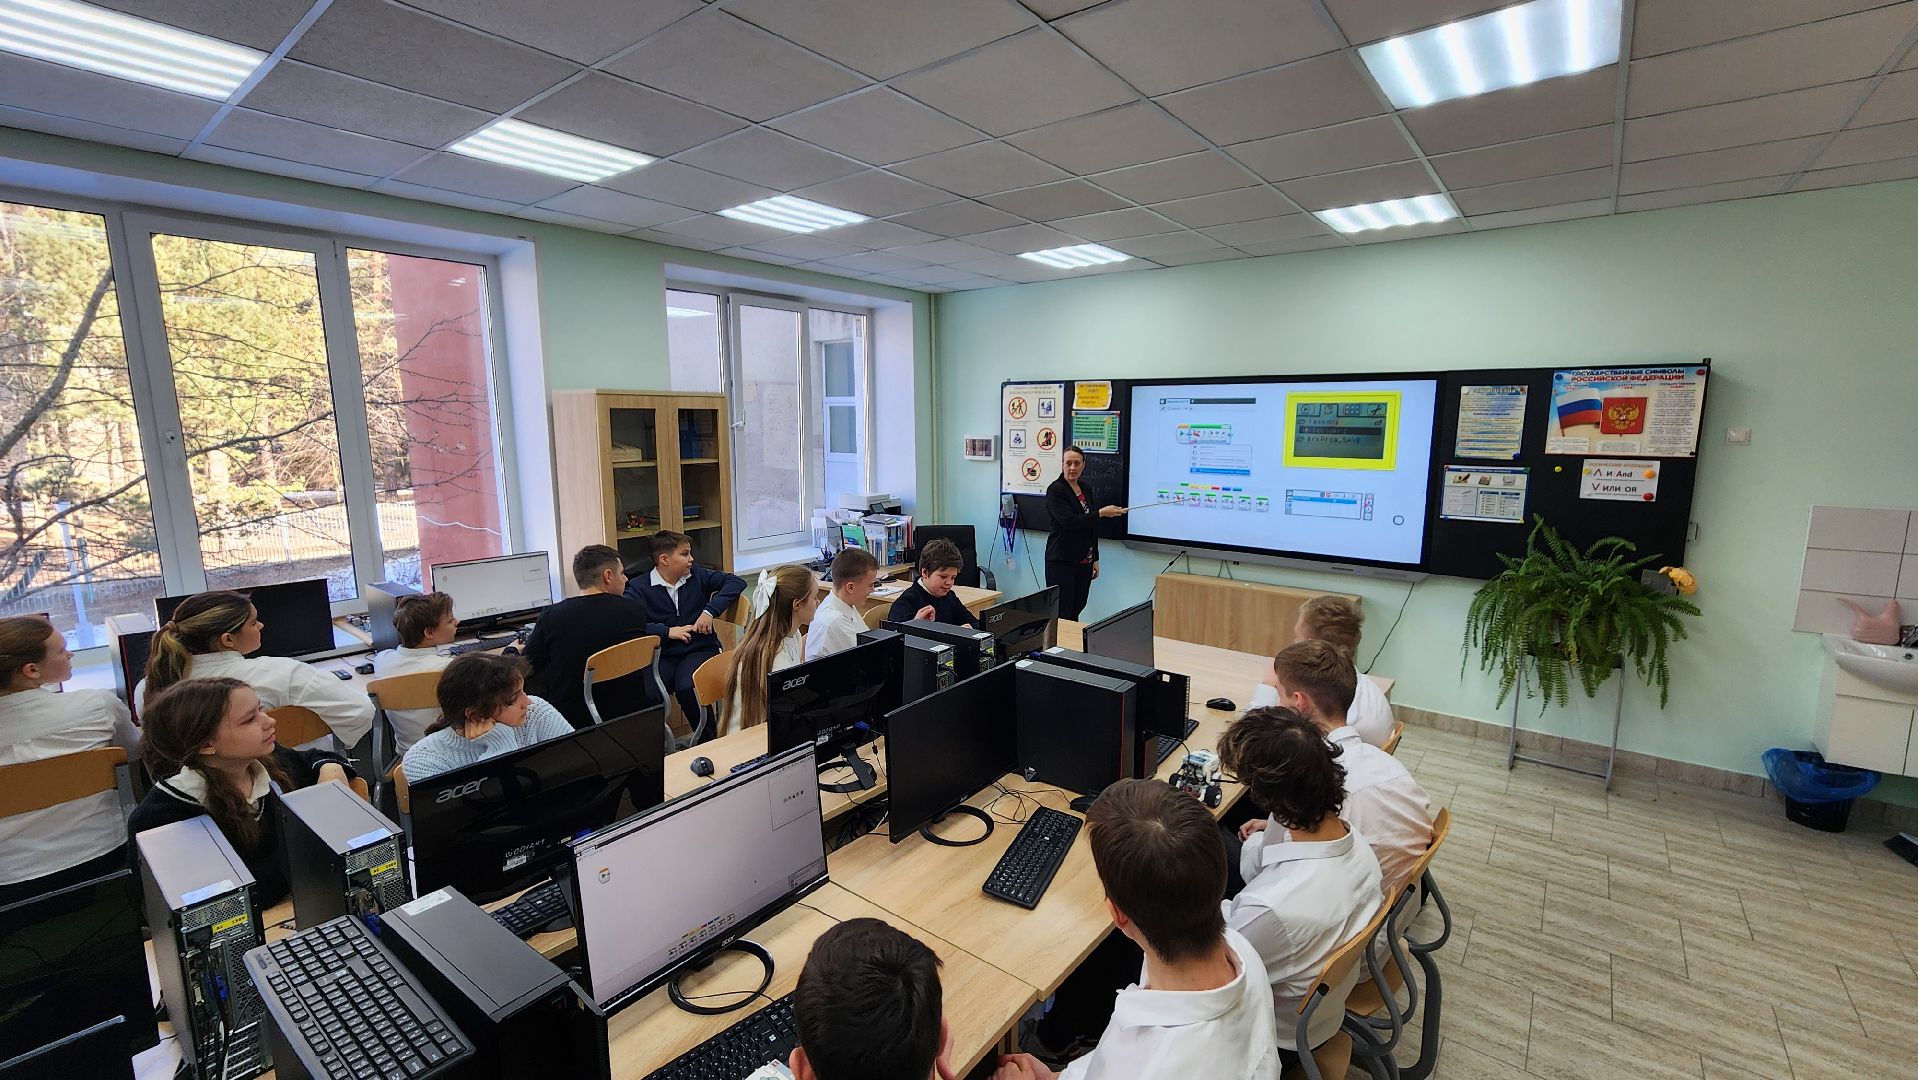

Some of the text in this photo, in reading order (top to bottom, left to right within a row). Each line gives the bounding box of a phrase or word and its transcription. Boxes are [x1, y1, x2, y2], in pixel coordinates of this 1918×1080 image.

[1645, 367, 1685, 375] СИМВОЛЫ
[1629, 374, 1685, 382] ФЕДЕРАЦИИ
[1616, 470, 1633, 478] And
[989, 611, 1005, 623] acer
[782, 674, 810, 691] acer
[436, 776, 489, 803] acer
[721, 935, 736, 946] acer
